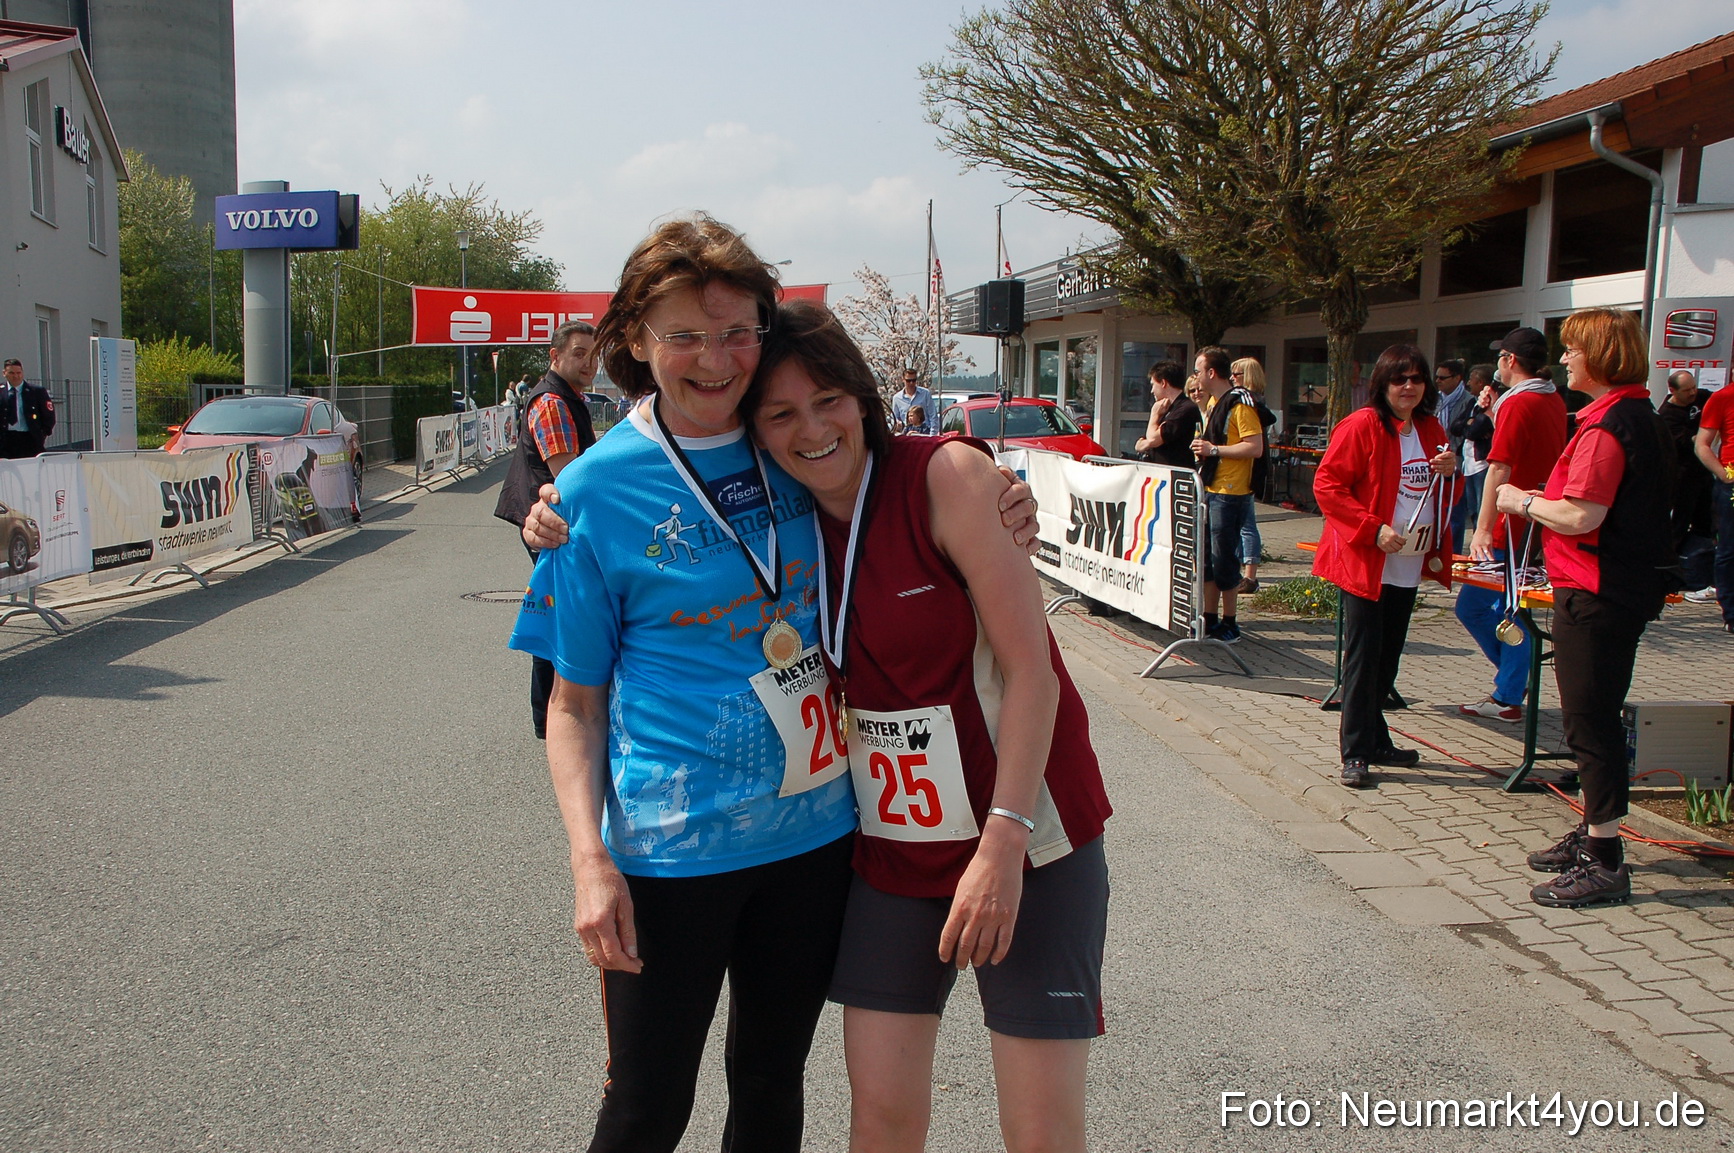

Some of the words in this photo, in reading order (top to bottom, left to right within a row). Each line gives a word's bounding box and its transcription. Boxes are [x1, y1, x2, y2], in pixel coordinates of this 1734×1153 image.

[63, 106, 90, 165] Bauer
[225, 207, 319, 231] VOLVO
[1655, 359, 1724, 369] SEAT
[727, 484, 763, 503] Fische
[1414, 525, 1431, 552] 11
[773, 652, 822, 688] MEYER
[780, 667, 826, 697] WERBUNG
[856, 717, 902, 737] MEYER
[859, 732, 905, 749] WERBUNG
[869, 751, 944, 828] 25
